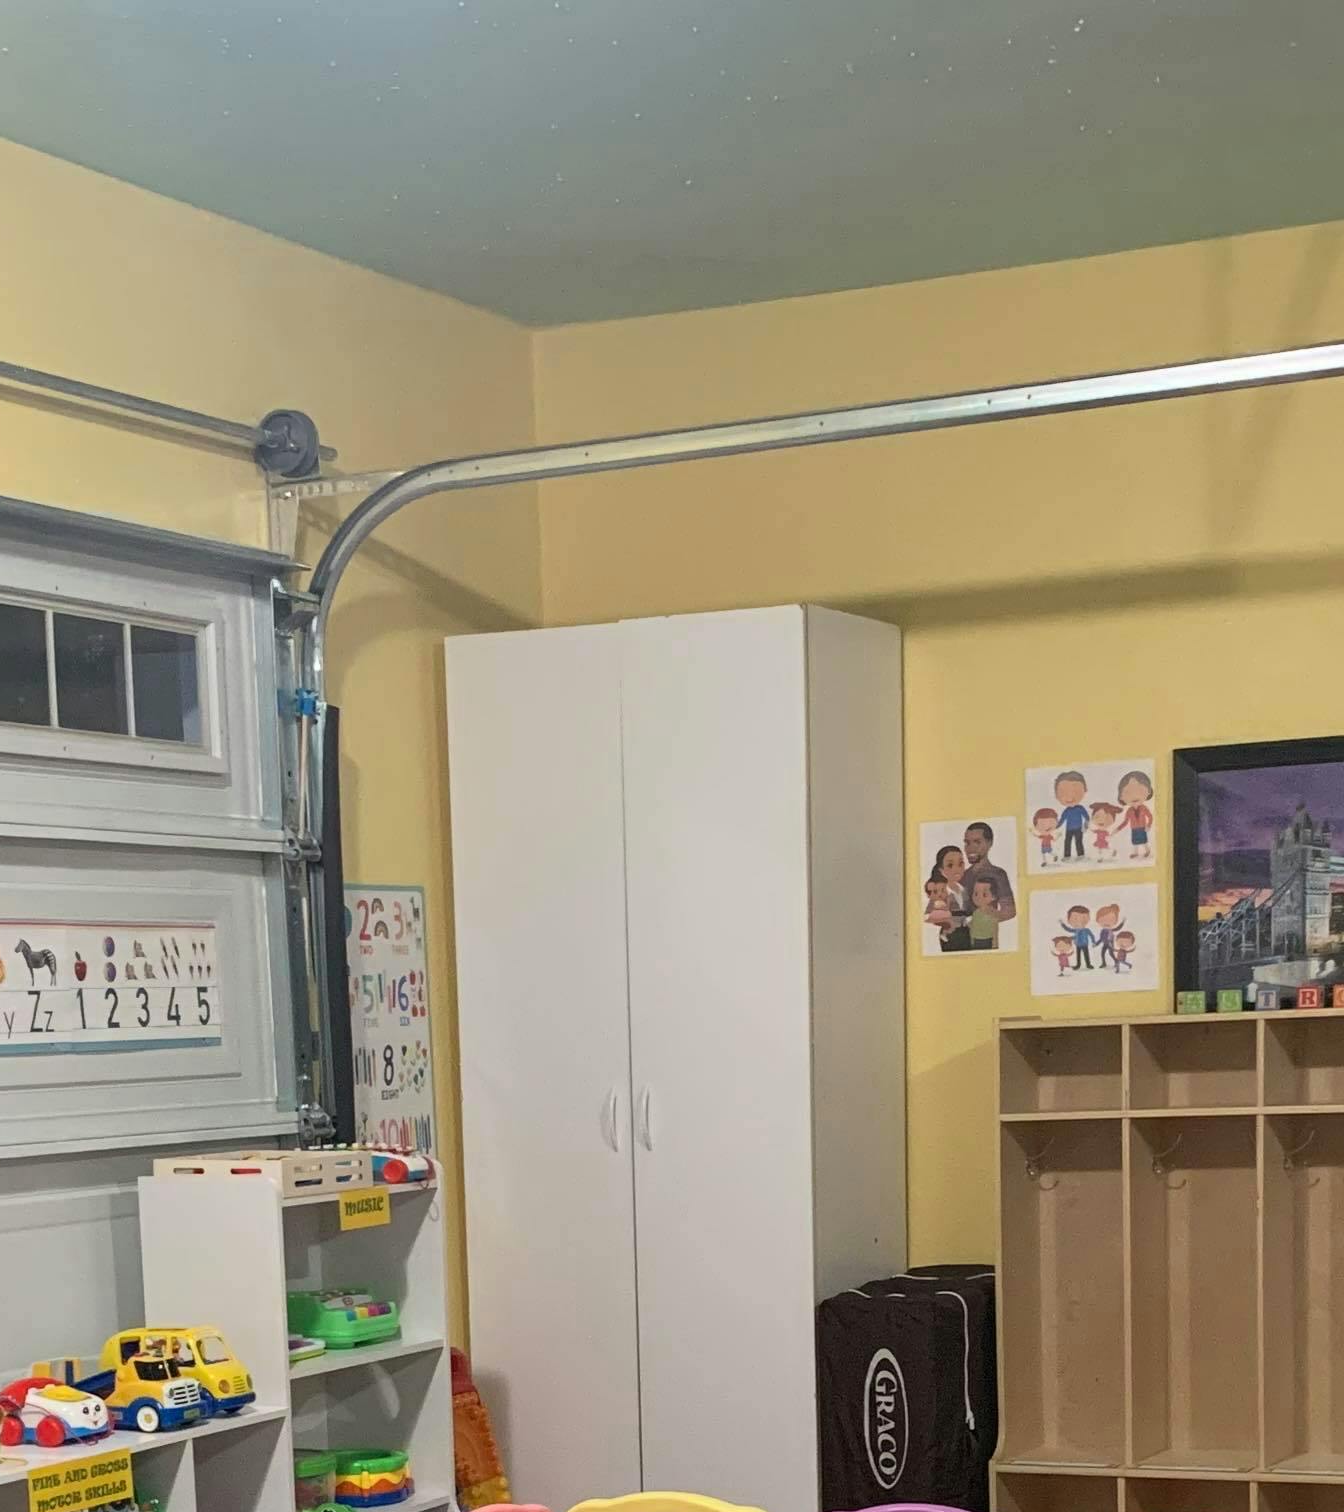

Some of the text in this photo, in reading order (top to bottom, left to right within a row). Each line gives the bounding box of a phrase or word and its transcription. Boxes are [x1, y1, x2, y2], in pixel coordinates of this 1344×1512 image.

[356, 899, 372, 941] 2
[75, 988, 87, 1030] 1
[104, 987, 121, 1029] 2
[135, 987, 151, 1028] 3
[167, 986, 181, 1027] 4
[196, 986, 211, 1026] 5
[397, 975, 409, 1011] 6
[383, 1044, 394, 1087] 8
[874, 1369, 898, 1475] GRACO
[31, 1457, 129, 1492] FINE AND GROSS
[36, 1479, 127, 1512] MOTOR SKILLS
